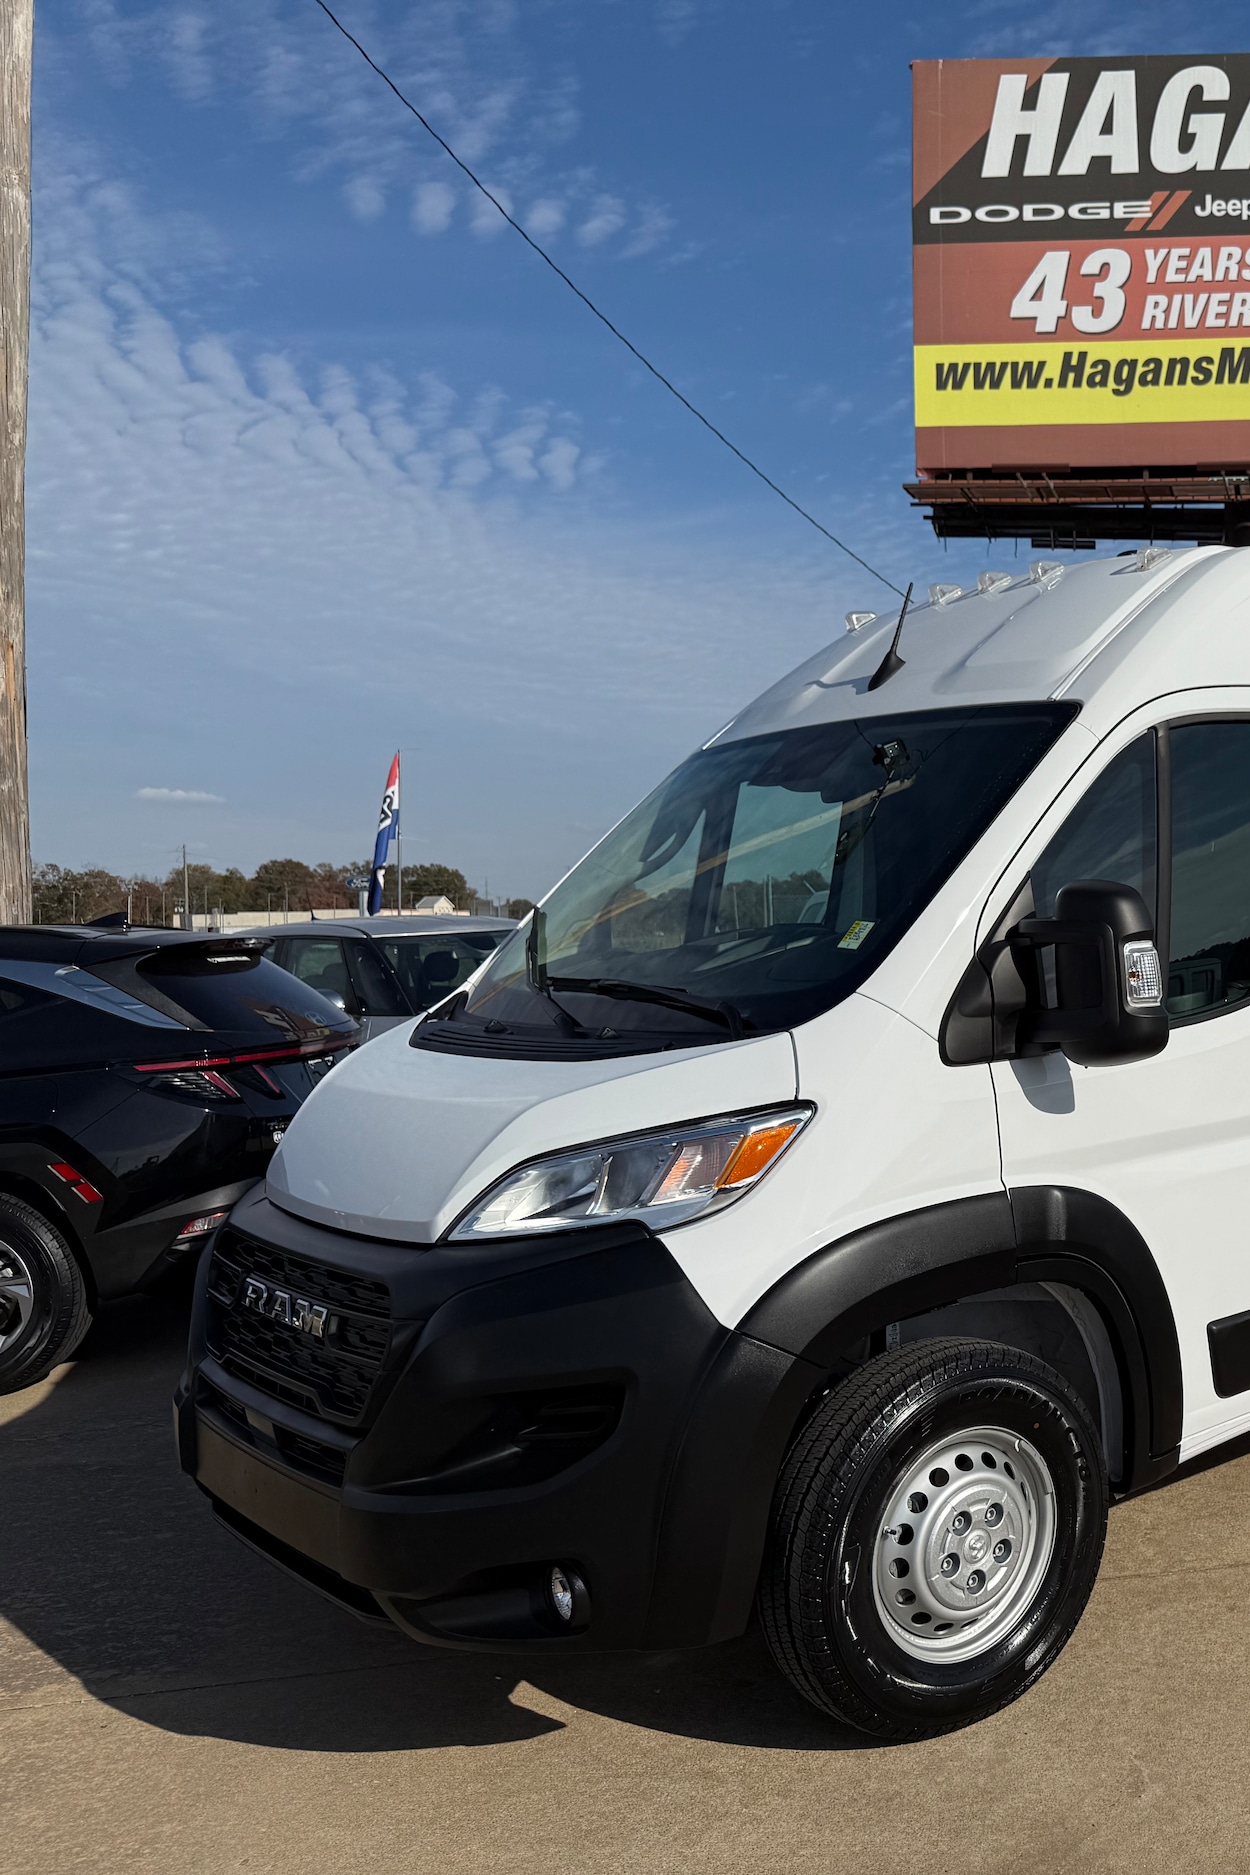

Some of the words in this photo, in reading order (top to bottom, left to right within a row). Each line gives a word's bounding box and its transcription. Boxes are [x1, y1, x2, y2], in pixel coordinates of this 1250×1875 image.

[929, 200, 1153, 225] DODGE
[1010, 248, 1132, 334] 43
[241, 1277, 329, 1338] RAM
